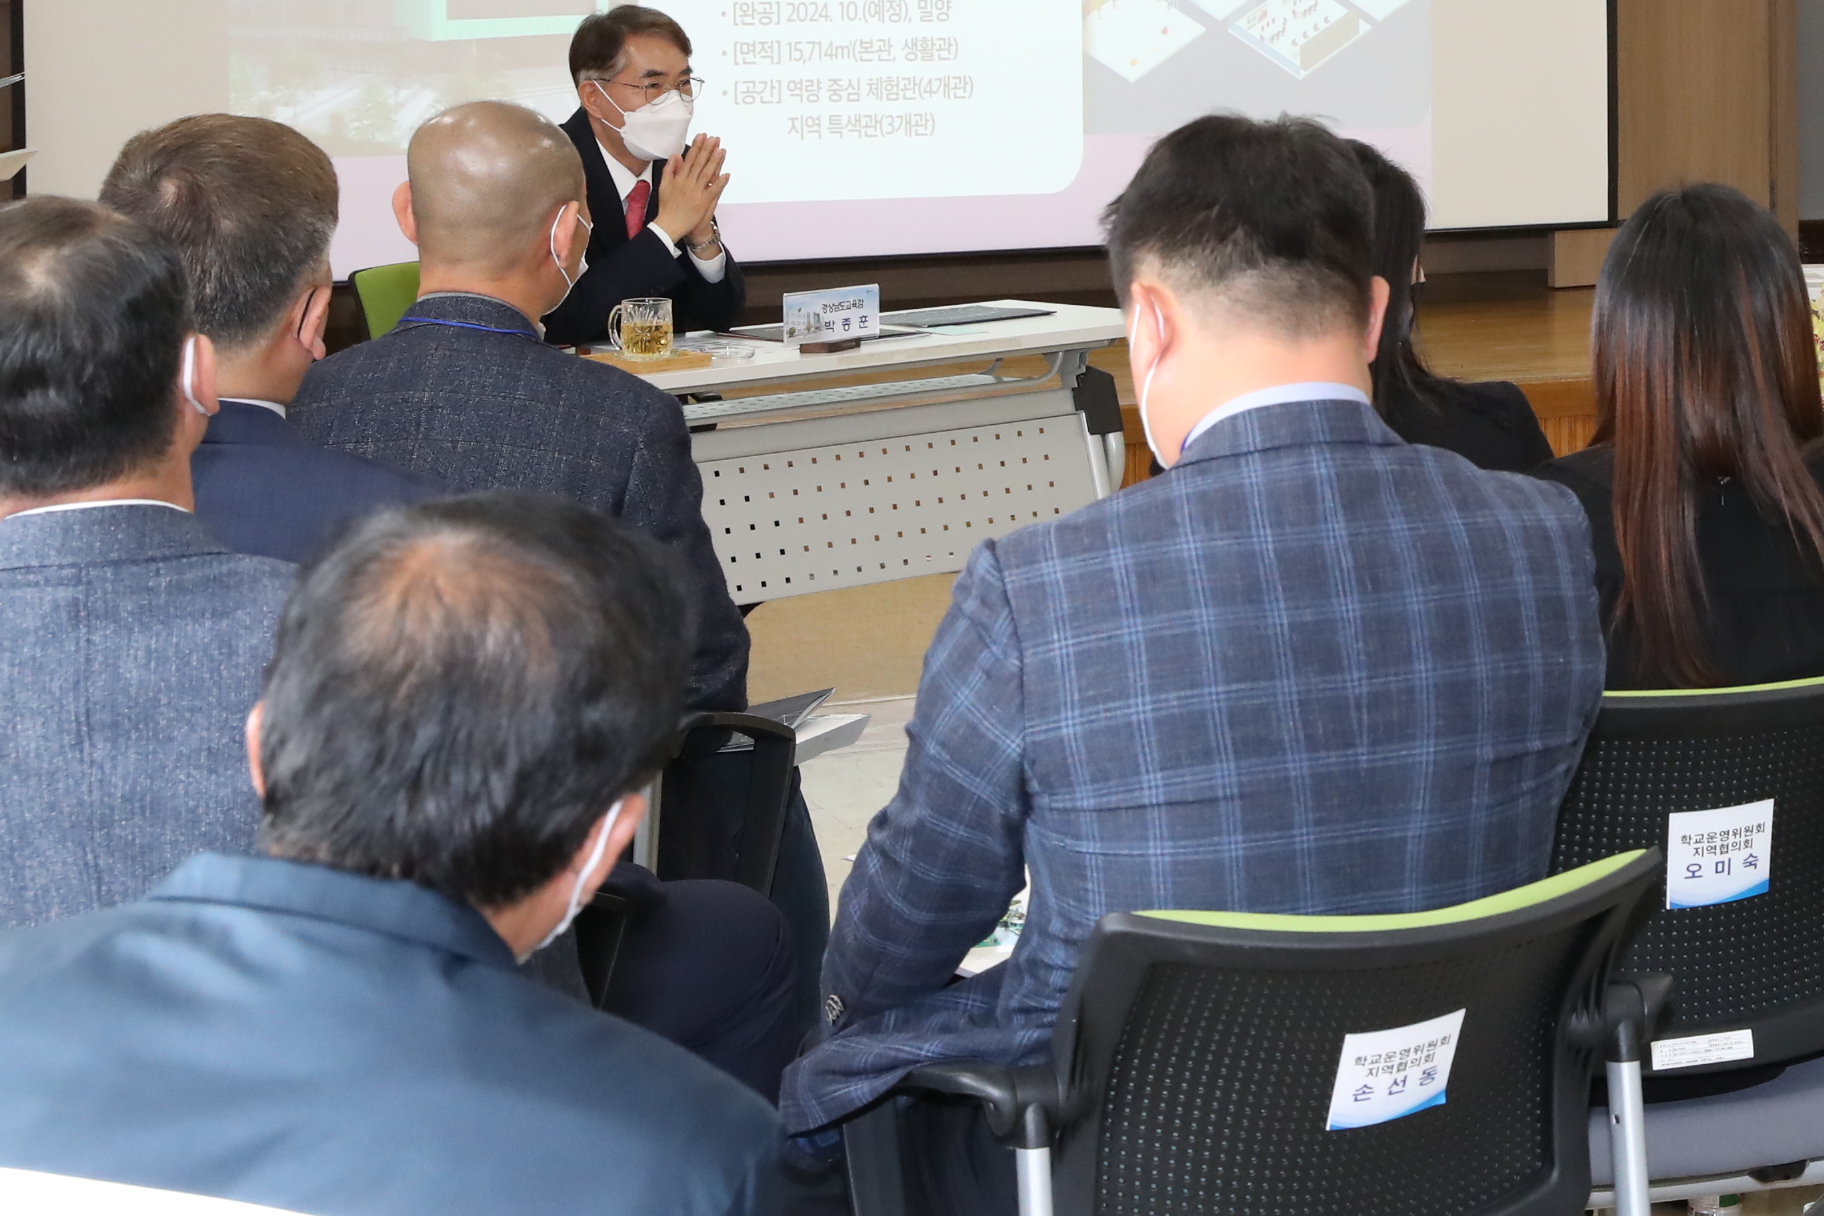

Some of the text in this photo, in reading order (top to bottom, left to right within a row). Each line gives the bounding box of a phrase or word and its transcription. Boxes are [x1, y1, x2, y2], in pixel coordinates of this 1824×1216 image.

[732, 0, 781, 27] [완공]
[785, 1, 834, 23] 2024.
[733, 40, 781, 66] [면적]
[902, 35, 959, 62] 생활관)
[734, 74, 974, 105] [공간] 역량 중심 체험관(4개관)
[787, 111, 936, 141] 지역 특색관(3개관)
[1680, 821, 1766, 846] 학교운영위원회
[1692, 837, 1754, 858] 지역협의회
[1354, 1033, 1452, 1068] 학교운영위원회
[1365, 1051, 1436, 1078] 지역협의회
